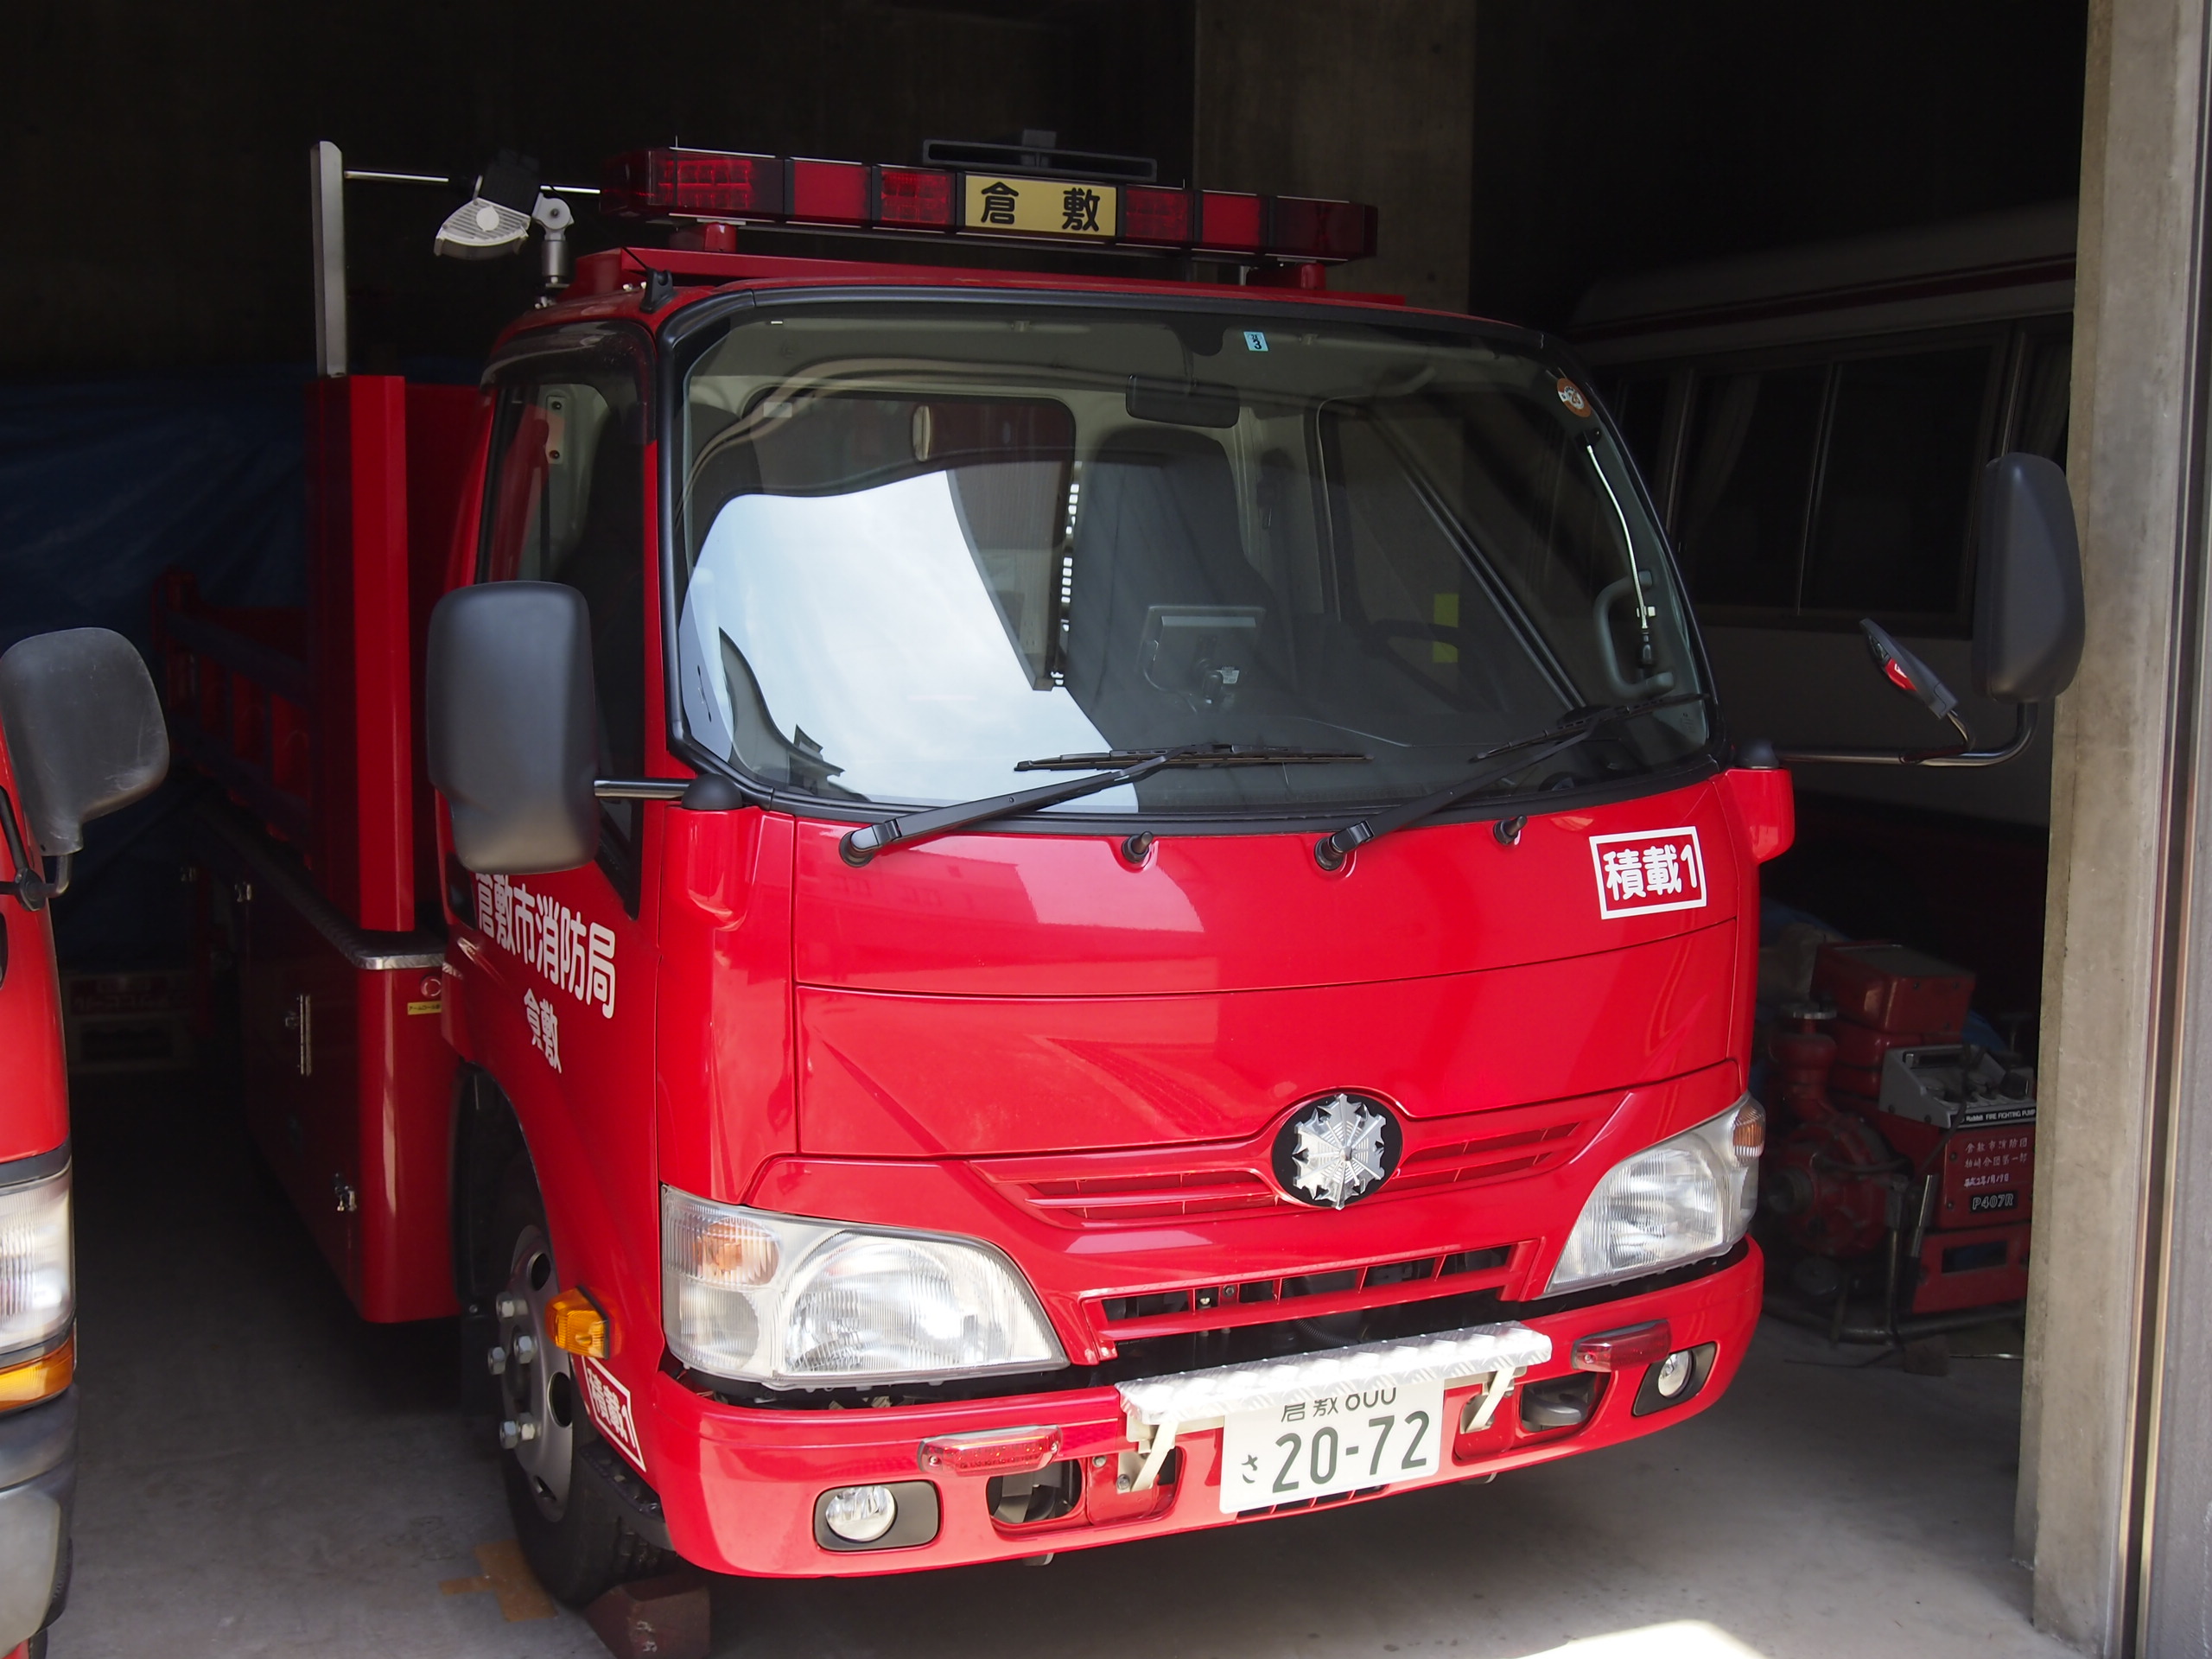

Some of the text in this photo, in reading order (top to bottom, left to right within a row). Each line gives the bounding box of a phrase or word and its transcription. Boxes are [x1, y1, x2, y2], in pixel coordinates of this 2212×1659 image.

[981, 181, 1100, 232] 倉敷
[1253, 340, 1262, 349] 3
[1603, 844, 1697, 900] 積載1
[476, 873, 615, 1018] 倉敷市消防局
[1998, 1110, 2021, 1119] FIGHTING
[1972, 1193, 2014, 1210] P407R
[1241, 1410, 1431, 1493] さ 20-72
